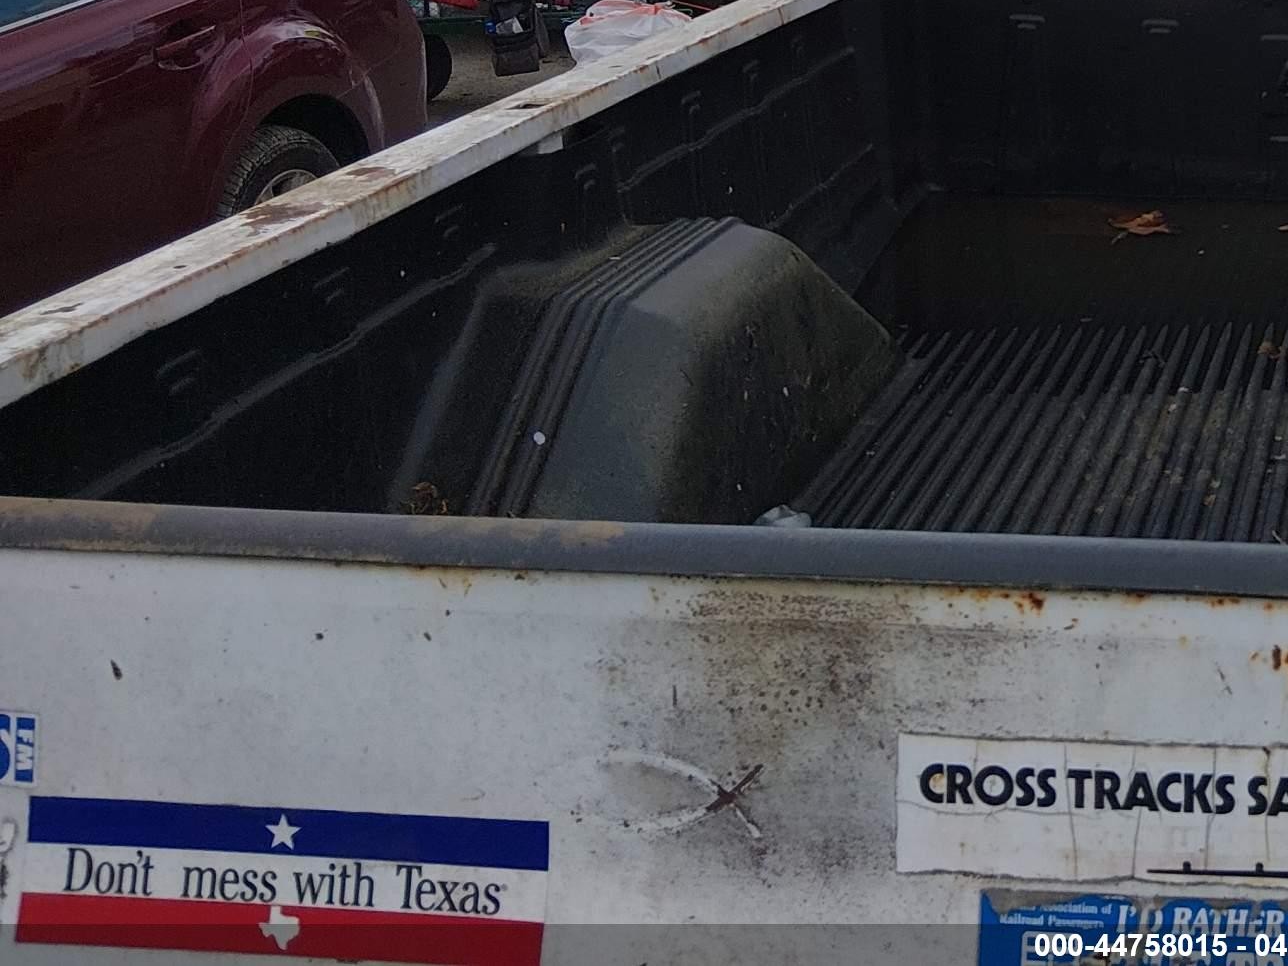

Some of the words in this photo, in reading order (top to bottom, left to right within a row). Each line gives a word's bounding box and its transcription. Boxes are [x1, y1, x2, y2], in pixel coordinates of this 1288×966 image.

[919, 763, 1057, 808] CROSS
[1066, 768, 1236, 814] TRACKS
[63, 847, 154, 897] Don't
[180, 864, 278, 904] mess
[293, 862, 375, 908] with
[395, 865, 501, 916] Texas
